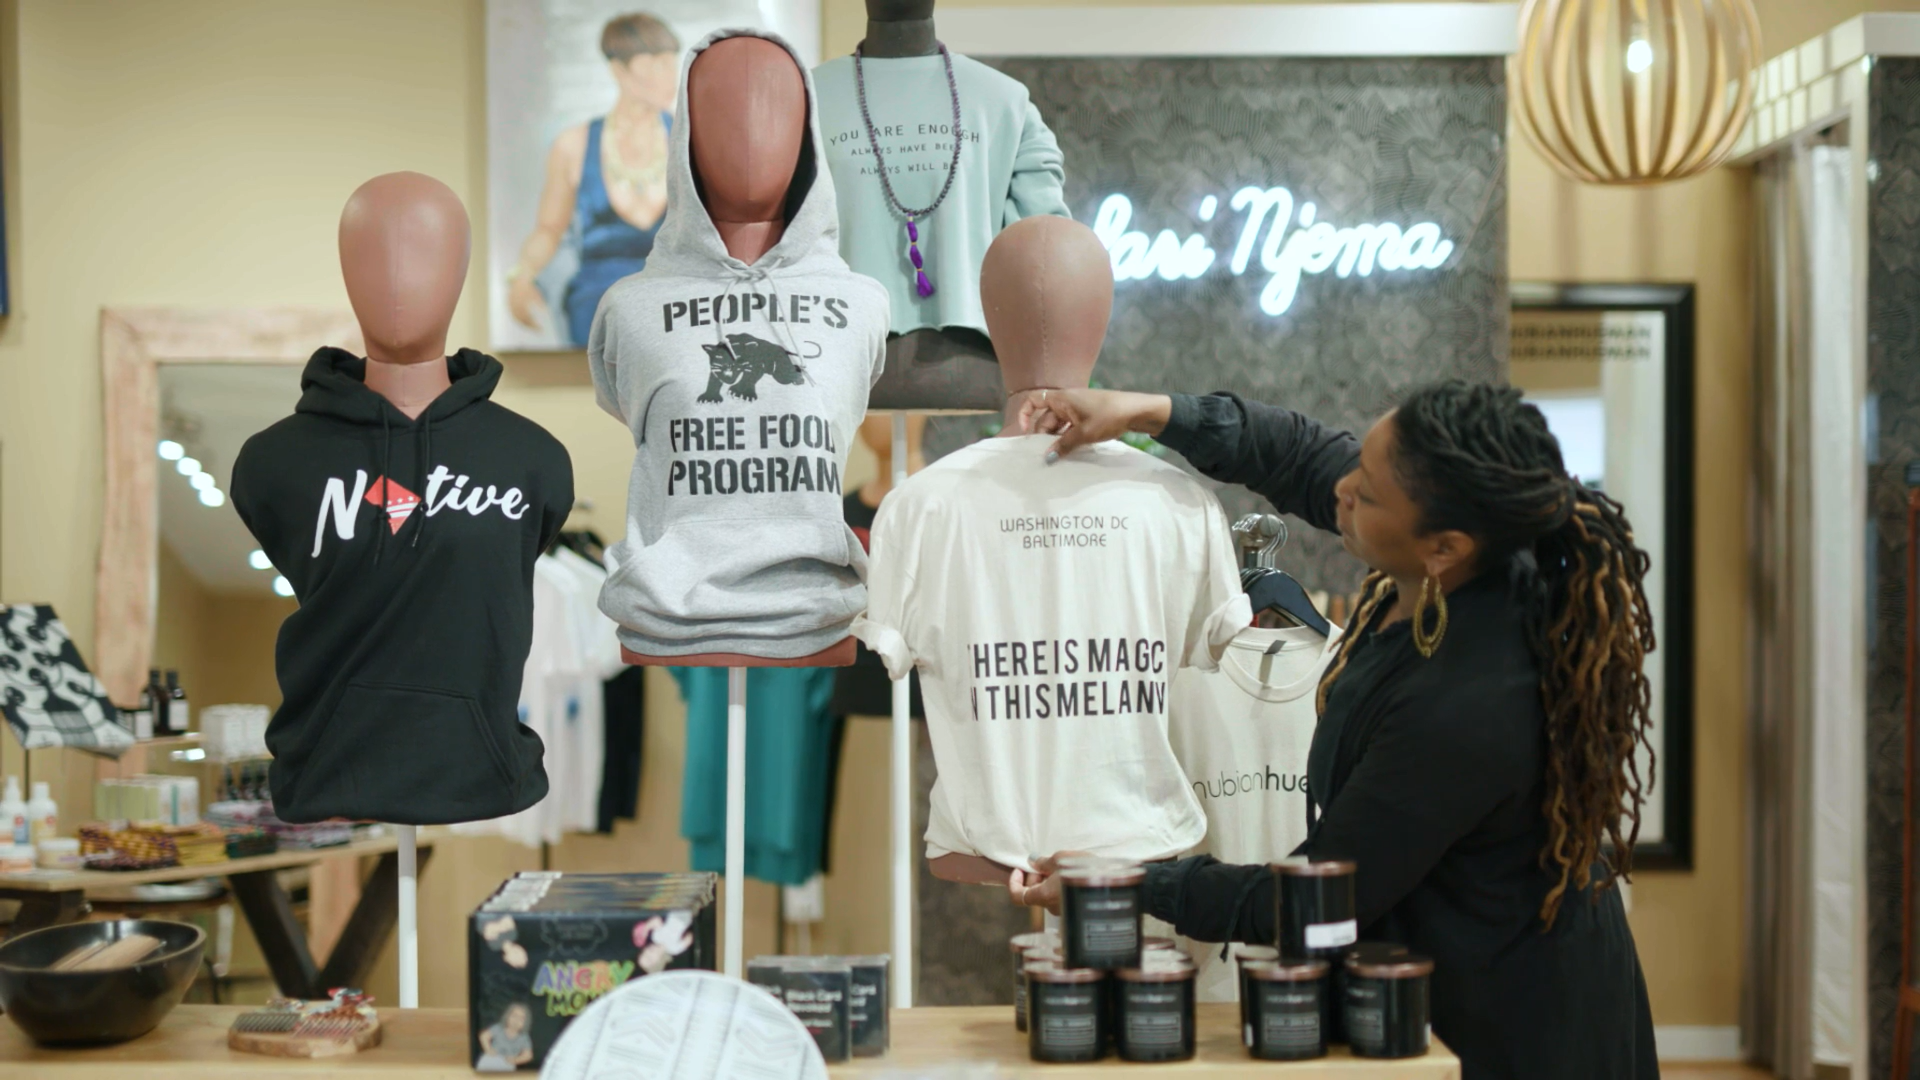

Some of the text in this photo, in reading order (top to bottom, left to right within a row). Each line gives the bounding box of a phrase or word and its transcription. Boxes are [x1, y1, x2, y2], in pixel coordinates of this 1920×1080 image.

[830, 130, 859, 146] YOU
[873, 125, 904, 137] ARE
[851, 143, 955, 156] ALWYS HAVE BEE
[860, 166, 900, 175] ALWYS
[908, 163, 935, 172] WILL
[1231, 186, 1454, 316] Njema
[663, 293, 849, 333] PEOPLE'S
[670, 417, 745, 453] FREE
[668, 455, 841, 496] PROGRAM
[1000, 515, 1129, 533] WASHINGTON DC
[1023, 533, 1107, 549] BALTIMORE
[966, 639, 1048, 679] HERE
[1053, 638, 1079, 675] IS
[985, 683, 1051, 720] THIS
[531, 959, 635, 997] ANGRY
